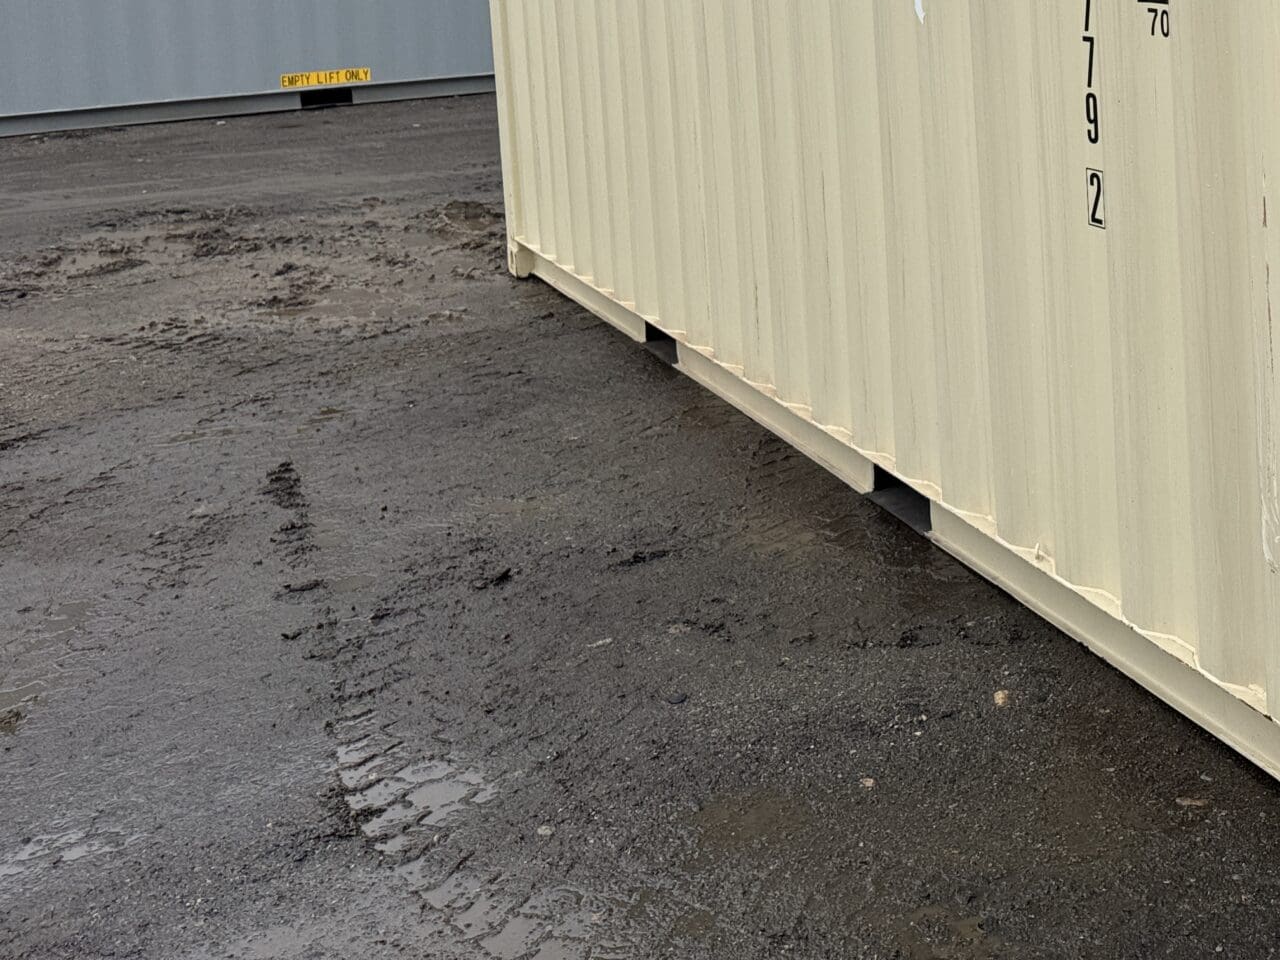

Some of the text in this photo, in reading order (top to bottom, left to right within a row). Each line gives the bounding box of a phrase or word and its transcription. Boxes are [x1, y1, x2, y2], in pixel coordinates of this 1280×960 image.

[1147, 7, 1170, 38] 70
[281, 69, 369, 87] EMPTY LIFT ONLY
